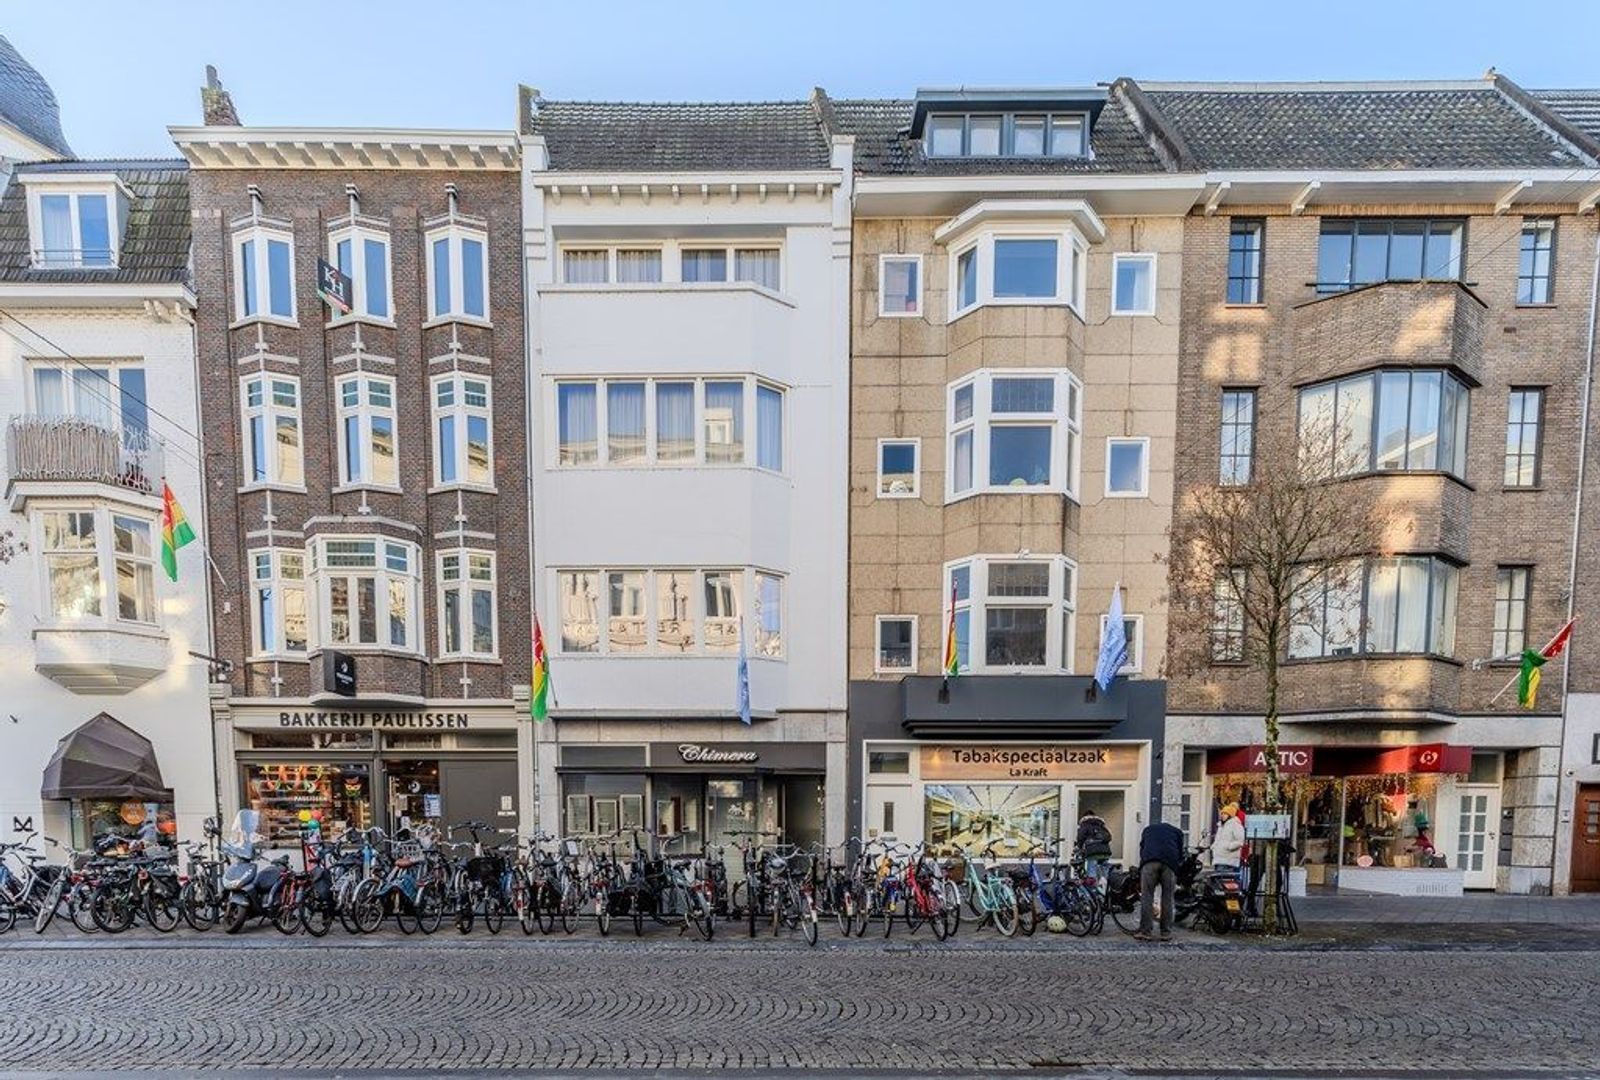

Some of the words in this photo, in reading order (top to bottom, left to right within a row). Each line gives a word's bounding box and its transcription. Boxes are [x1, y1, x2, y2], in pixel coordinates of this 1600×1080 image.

[280, 712, 365, 727] BAKKERIJ
[372, 713, 468, 728] PAULISSEN
[678, 743, 758, 761] Chimera
[952, 749, 1106, 766] Tabakspeciaalzaak
[1253, 751, 1308, 766] ATIC
[1009, 768, 1021, 777] La
[1022, 768, 1048, 777] Kraft
